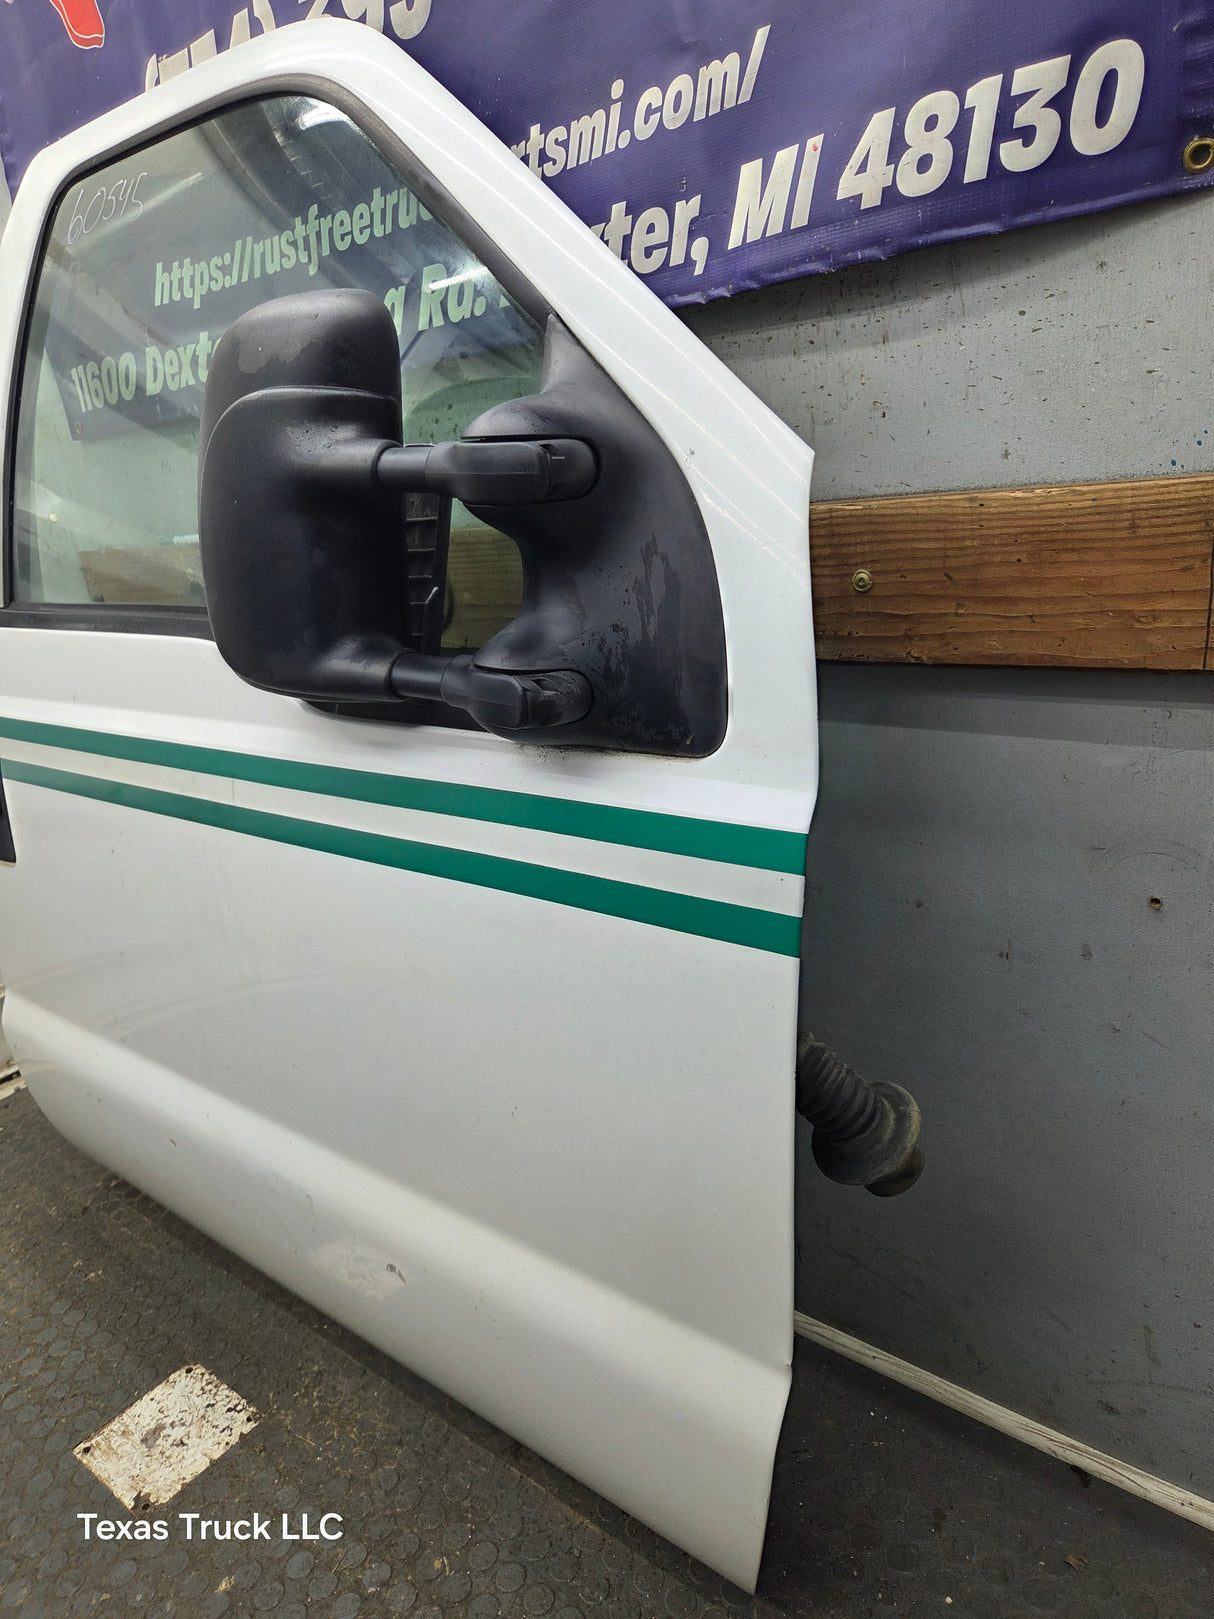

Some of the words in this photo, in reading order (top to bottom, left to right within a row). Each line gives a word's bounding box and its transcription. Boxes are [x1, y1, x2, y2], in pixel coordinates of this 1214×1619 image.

[68, 172, 148, 244] 60545
[71, 352, 136, 413] 11600
[145, 331, 222, 396] Dext
[727, 133, 824, 250] MI
[836, 39, 1145, 210] 48130
